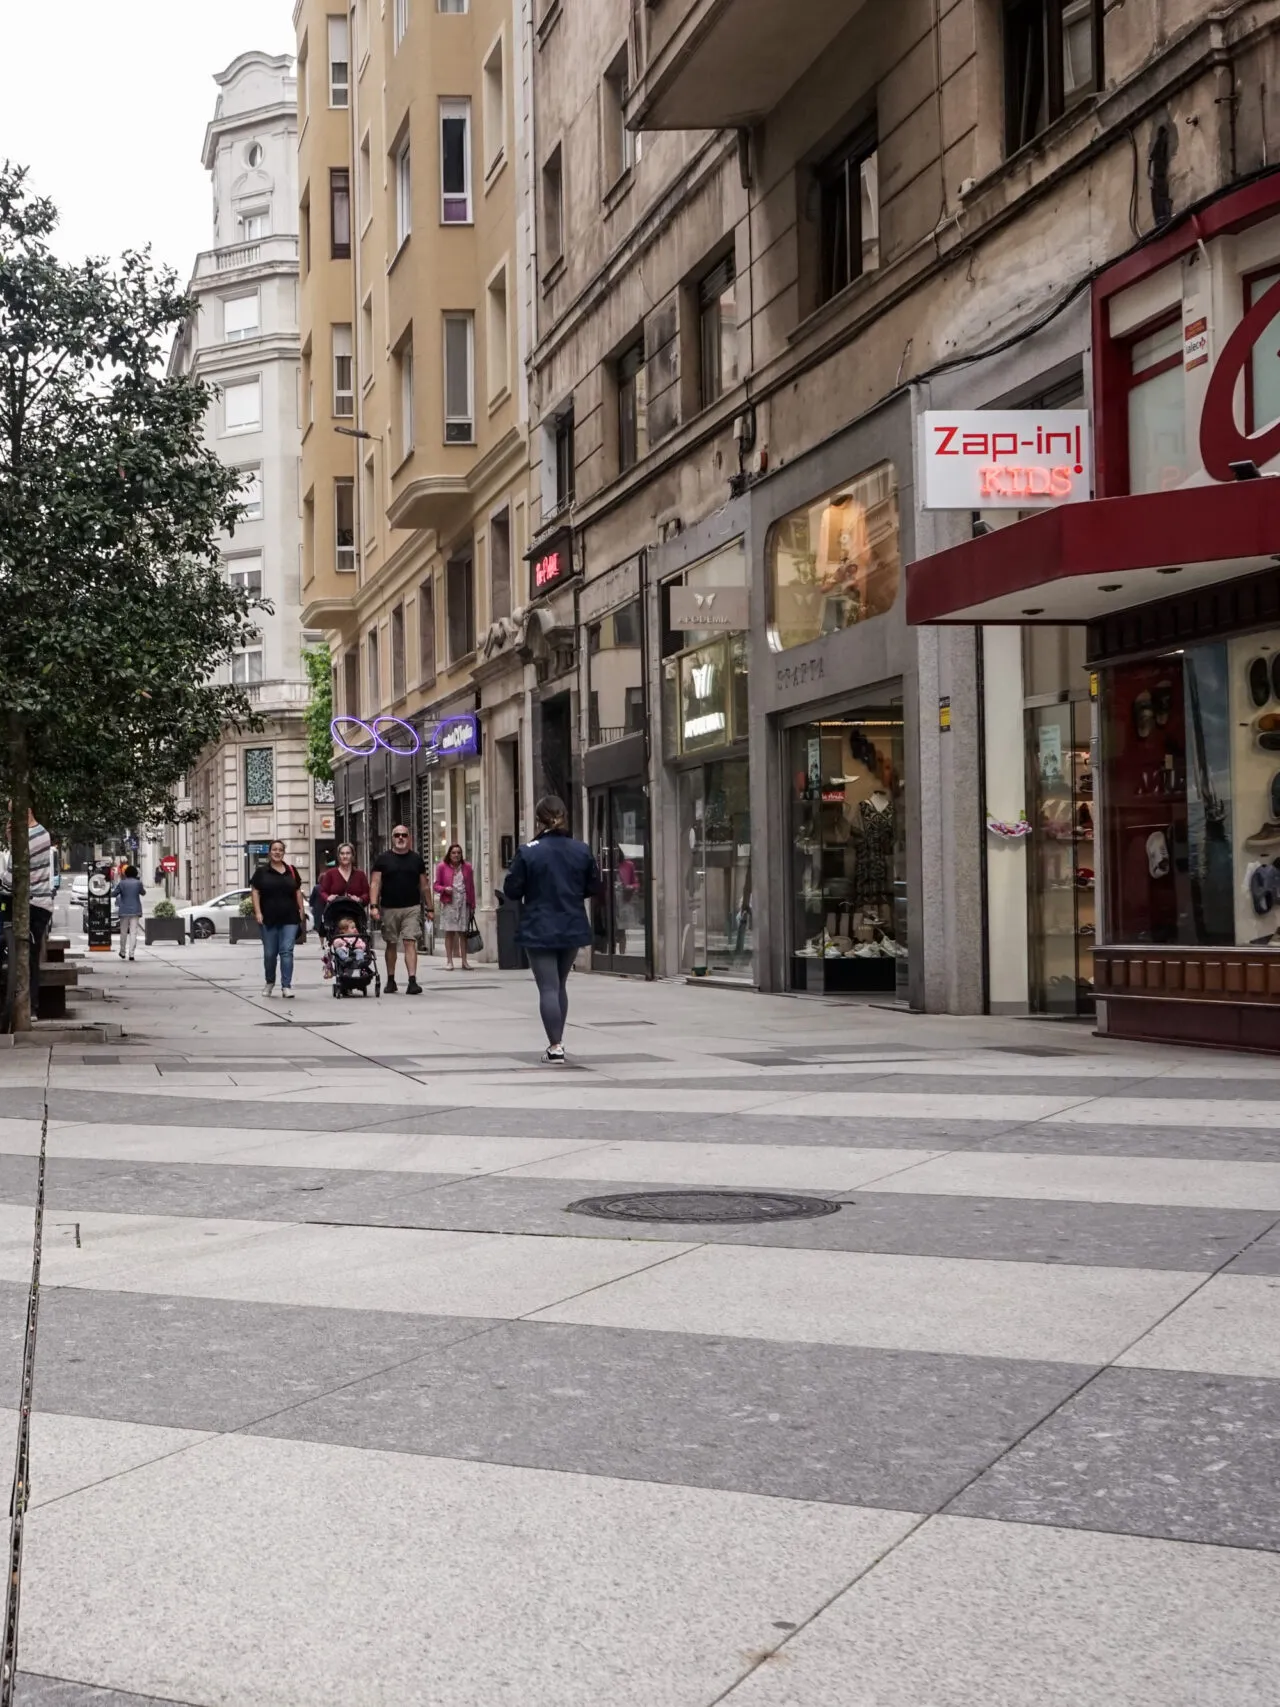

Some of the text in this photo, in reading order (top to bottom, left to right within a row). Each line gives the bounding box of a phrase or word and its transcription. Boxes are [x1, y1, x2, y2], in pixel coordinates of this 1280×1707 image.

[934, 425, 1083, 474] Zap-in!
[979, 466, 1072, 496] KIDS
[678, 615, 731, 625] APODEMIA
